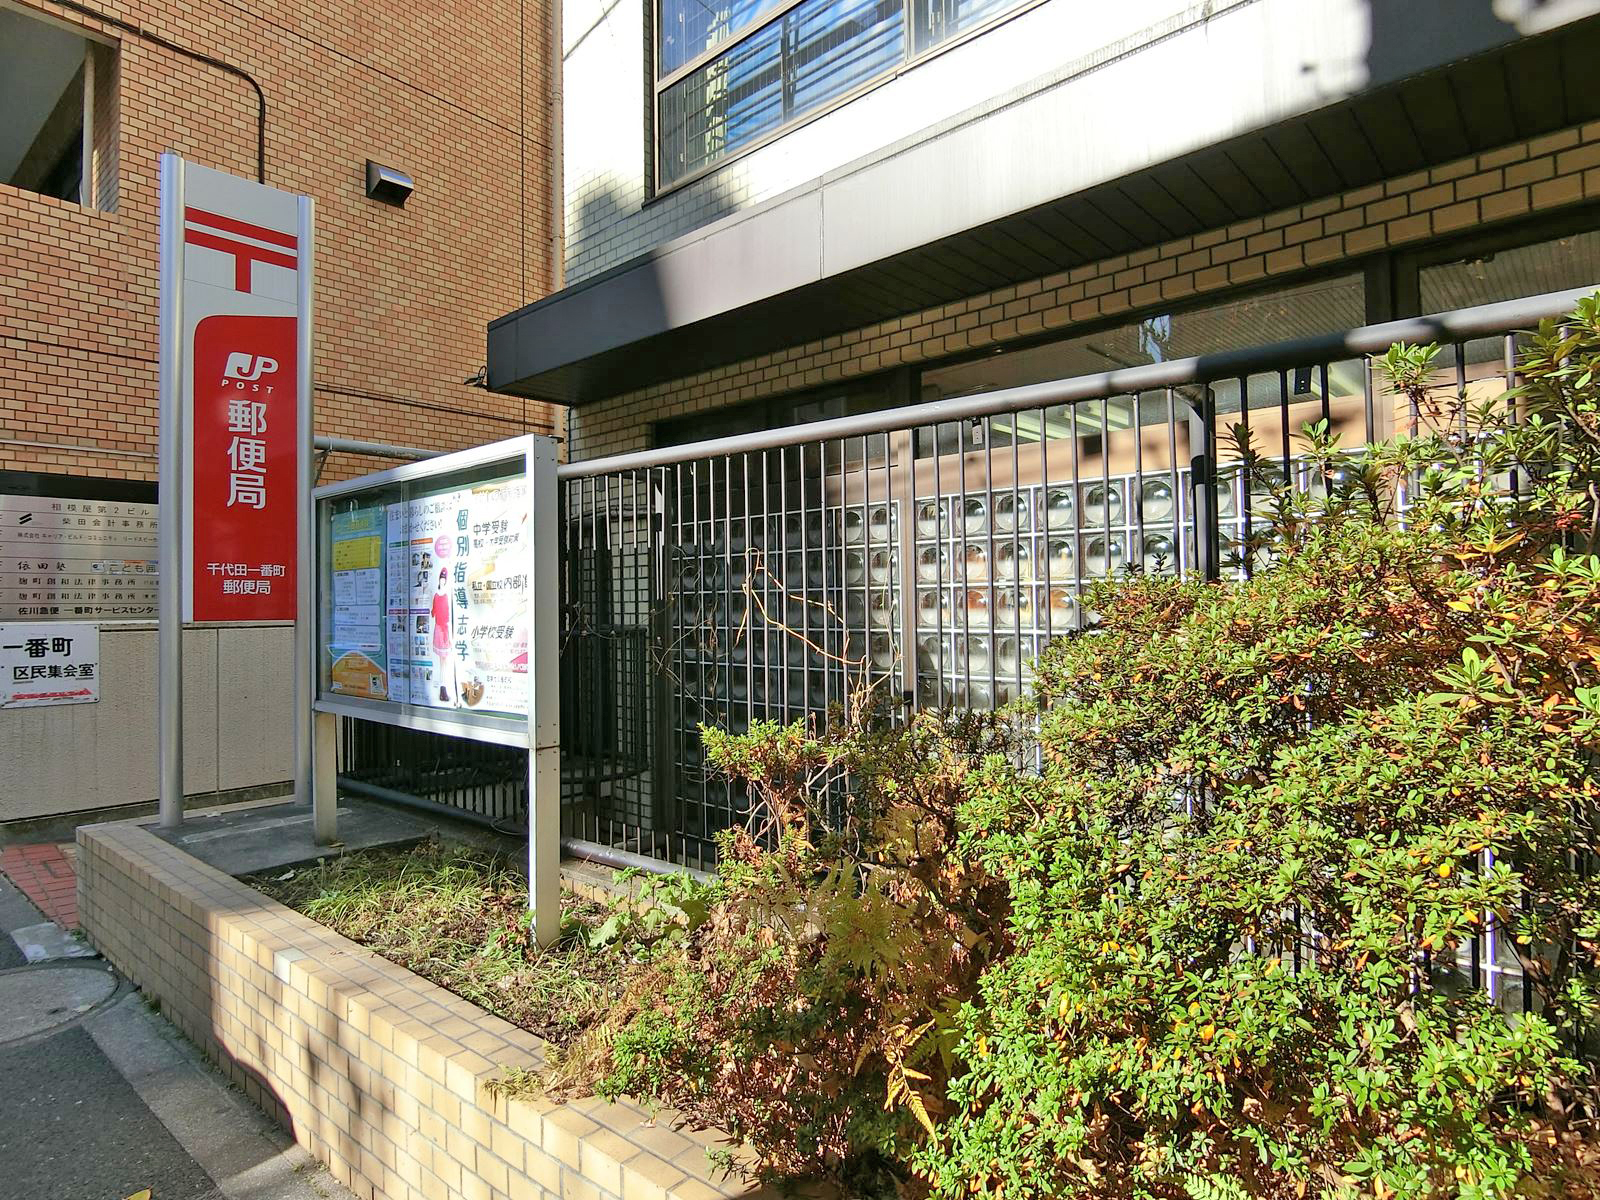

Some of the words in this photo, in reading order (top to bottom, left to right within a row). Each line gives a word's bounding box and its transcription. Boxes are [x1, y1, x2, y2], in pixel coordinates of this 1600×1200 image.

[221, 379, 274, 394] POST
[226, 400, 268, 510] 郵便局
[51, 503, 150, 516] 相模屋第2ビル
[62, 517, 158, 529] 柴田会計事務所
[473, 519, 509, 536] 中学受験
[206, 563, 286, 577] 千代田一番町
[222, 579, 272, 595] 郵便局
[453, 508, 470, 662] 個別指導志学
[18, 606, 60, 616] 佐川急便
[471, 624, 514, 640] 小学校受験
[2, 637, 74, 658] 一番町
[12, 663, 95, 681] 区民集会室
